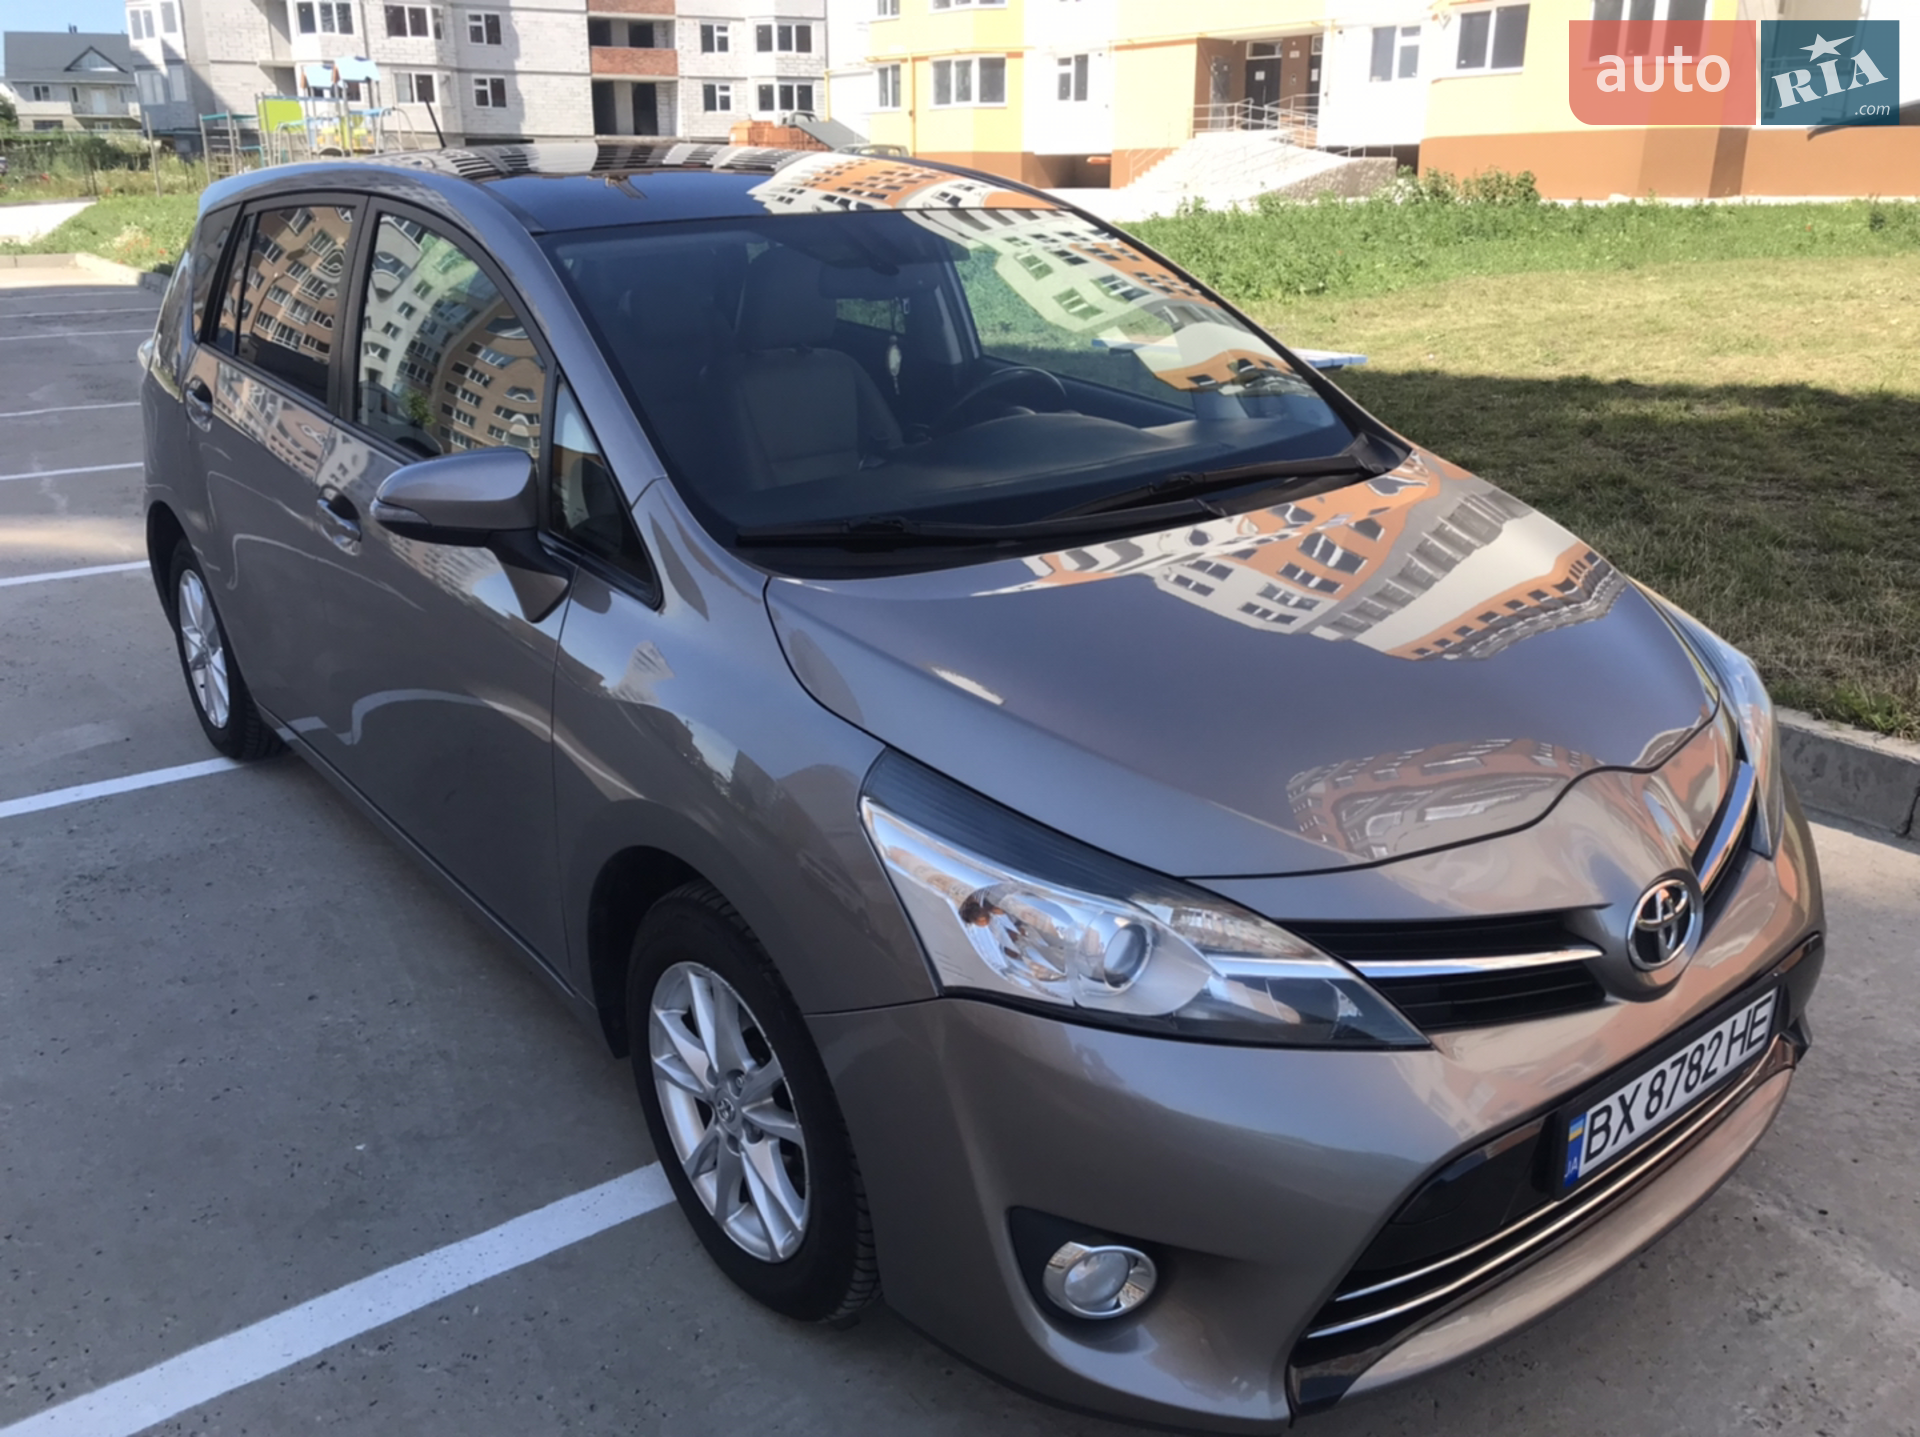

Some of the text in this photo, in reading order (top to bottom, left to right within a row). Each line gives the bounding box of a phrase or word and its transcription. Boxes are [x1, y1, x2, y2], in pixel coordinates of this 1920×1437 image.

[1583, 995, 1774, 1164] BX 8782 HE
